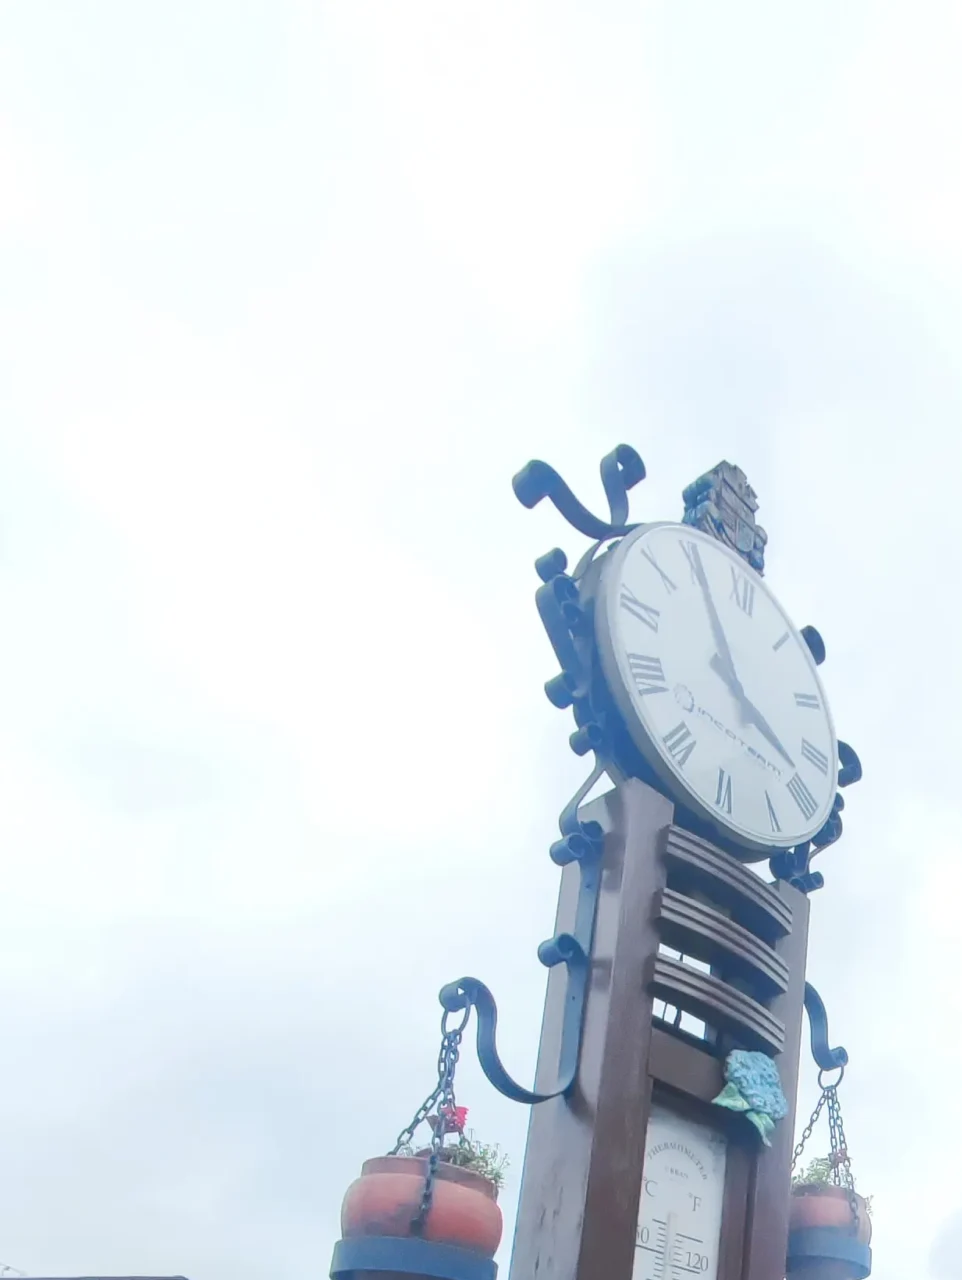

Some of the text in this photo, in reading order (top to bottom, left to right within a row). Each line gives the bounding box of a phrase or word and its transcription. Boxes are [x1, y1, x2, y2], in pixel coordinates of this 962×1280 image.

[730, 565, 756, 618] XII
[794, 692, 821, 710] II
[801, 737, 828, 776] III
[686, 1251, 709, 1272] 120
